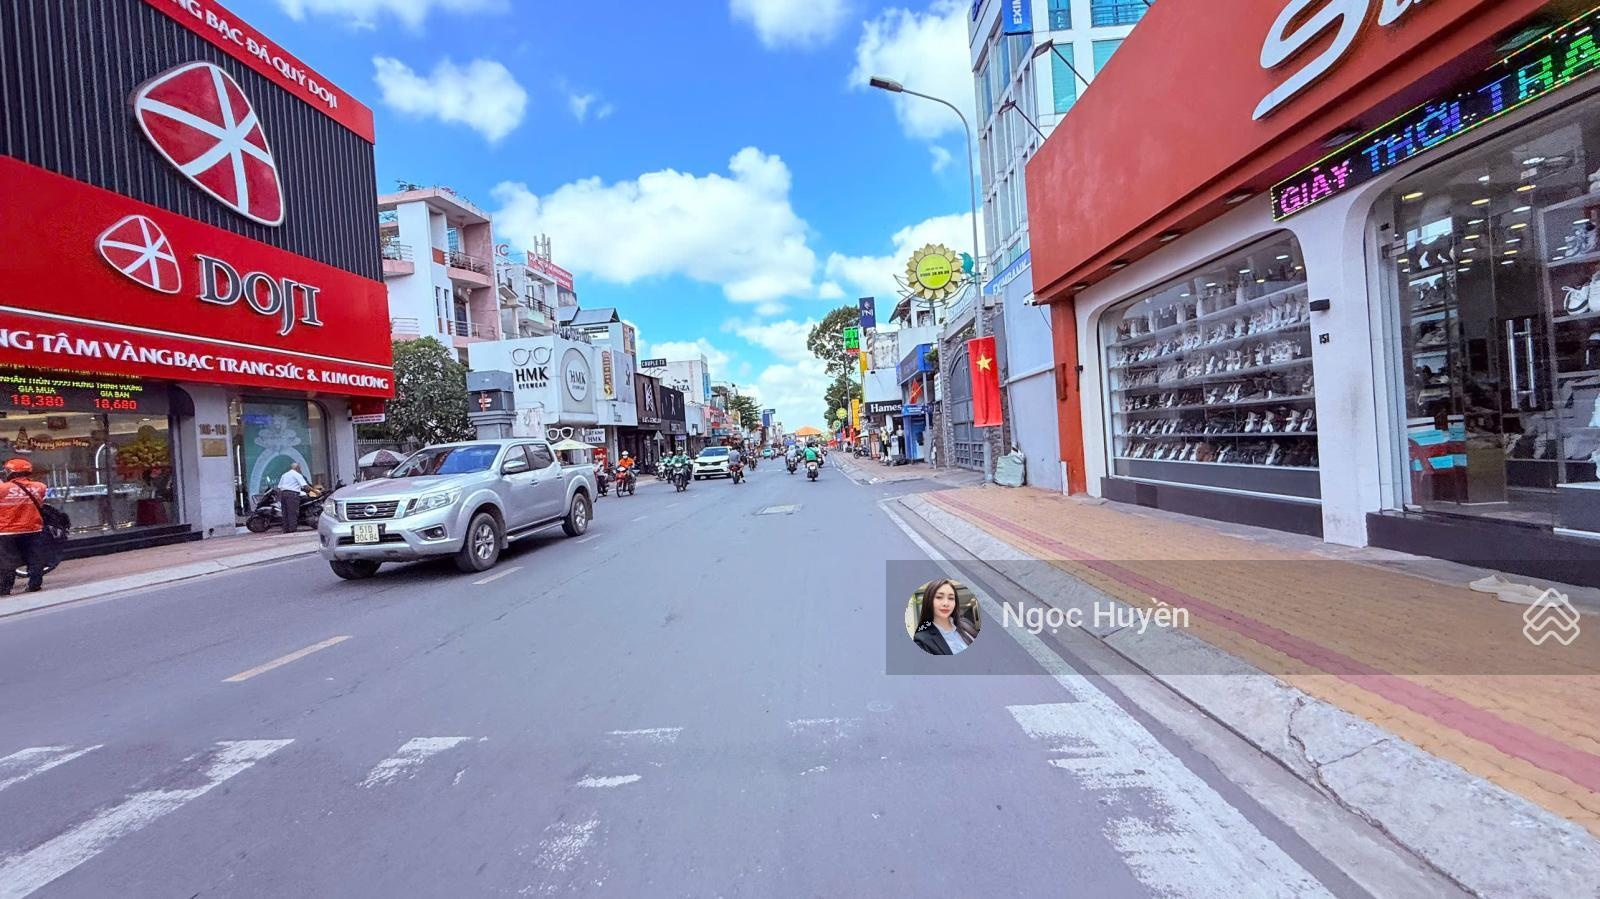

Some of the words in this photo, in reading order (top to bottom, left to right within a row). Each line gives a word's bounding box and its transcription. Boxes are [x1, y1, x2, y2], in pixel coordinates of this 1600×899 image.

[205, 10, 243, 46] BẠC
[246, 37, 272, 65] ĐÁ
[272, 57, 306, 87] QUÝ
[308, 78, 337, 109] DOJI
[195, 253, 323, 336] DOJI
[36, 332, 101, 358] TÂM
[103, 340, 173, 366] VÀNG
[174, 352, 214, 371] BẠC
[216, 357, 275, 377] TRANG
[306, 368, 320, 382] &
[321, 370, 348, 385] KIM
[515, 366, 549, 382] HMK
[569, 369, 586, 385] HMK
[870, 403, 902, 413] Hames
